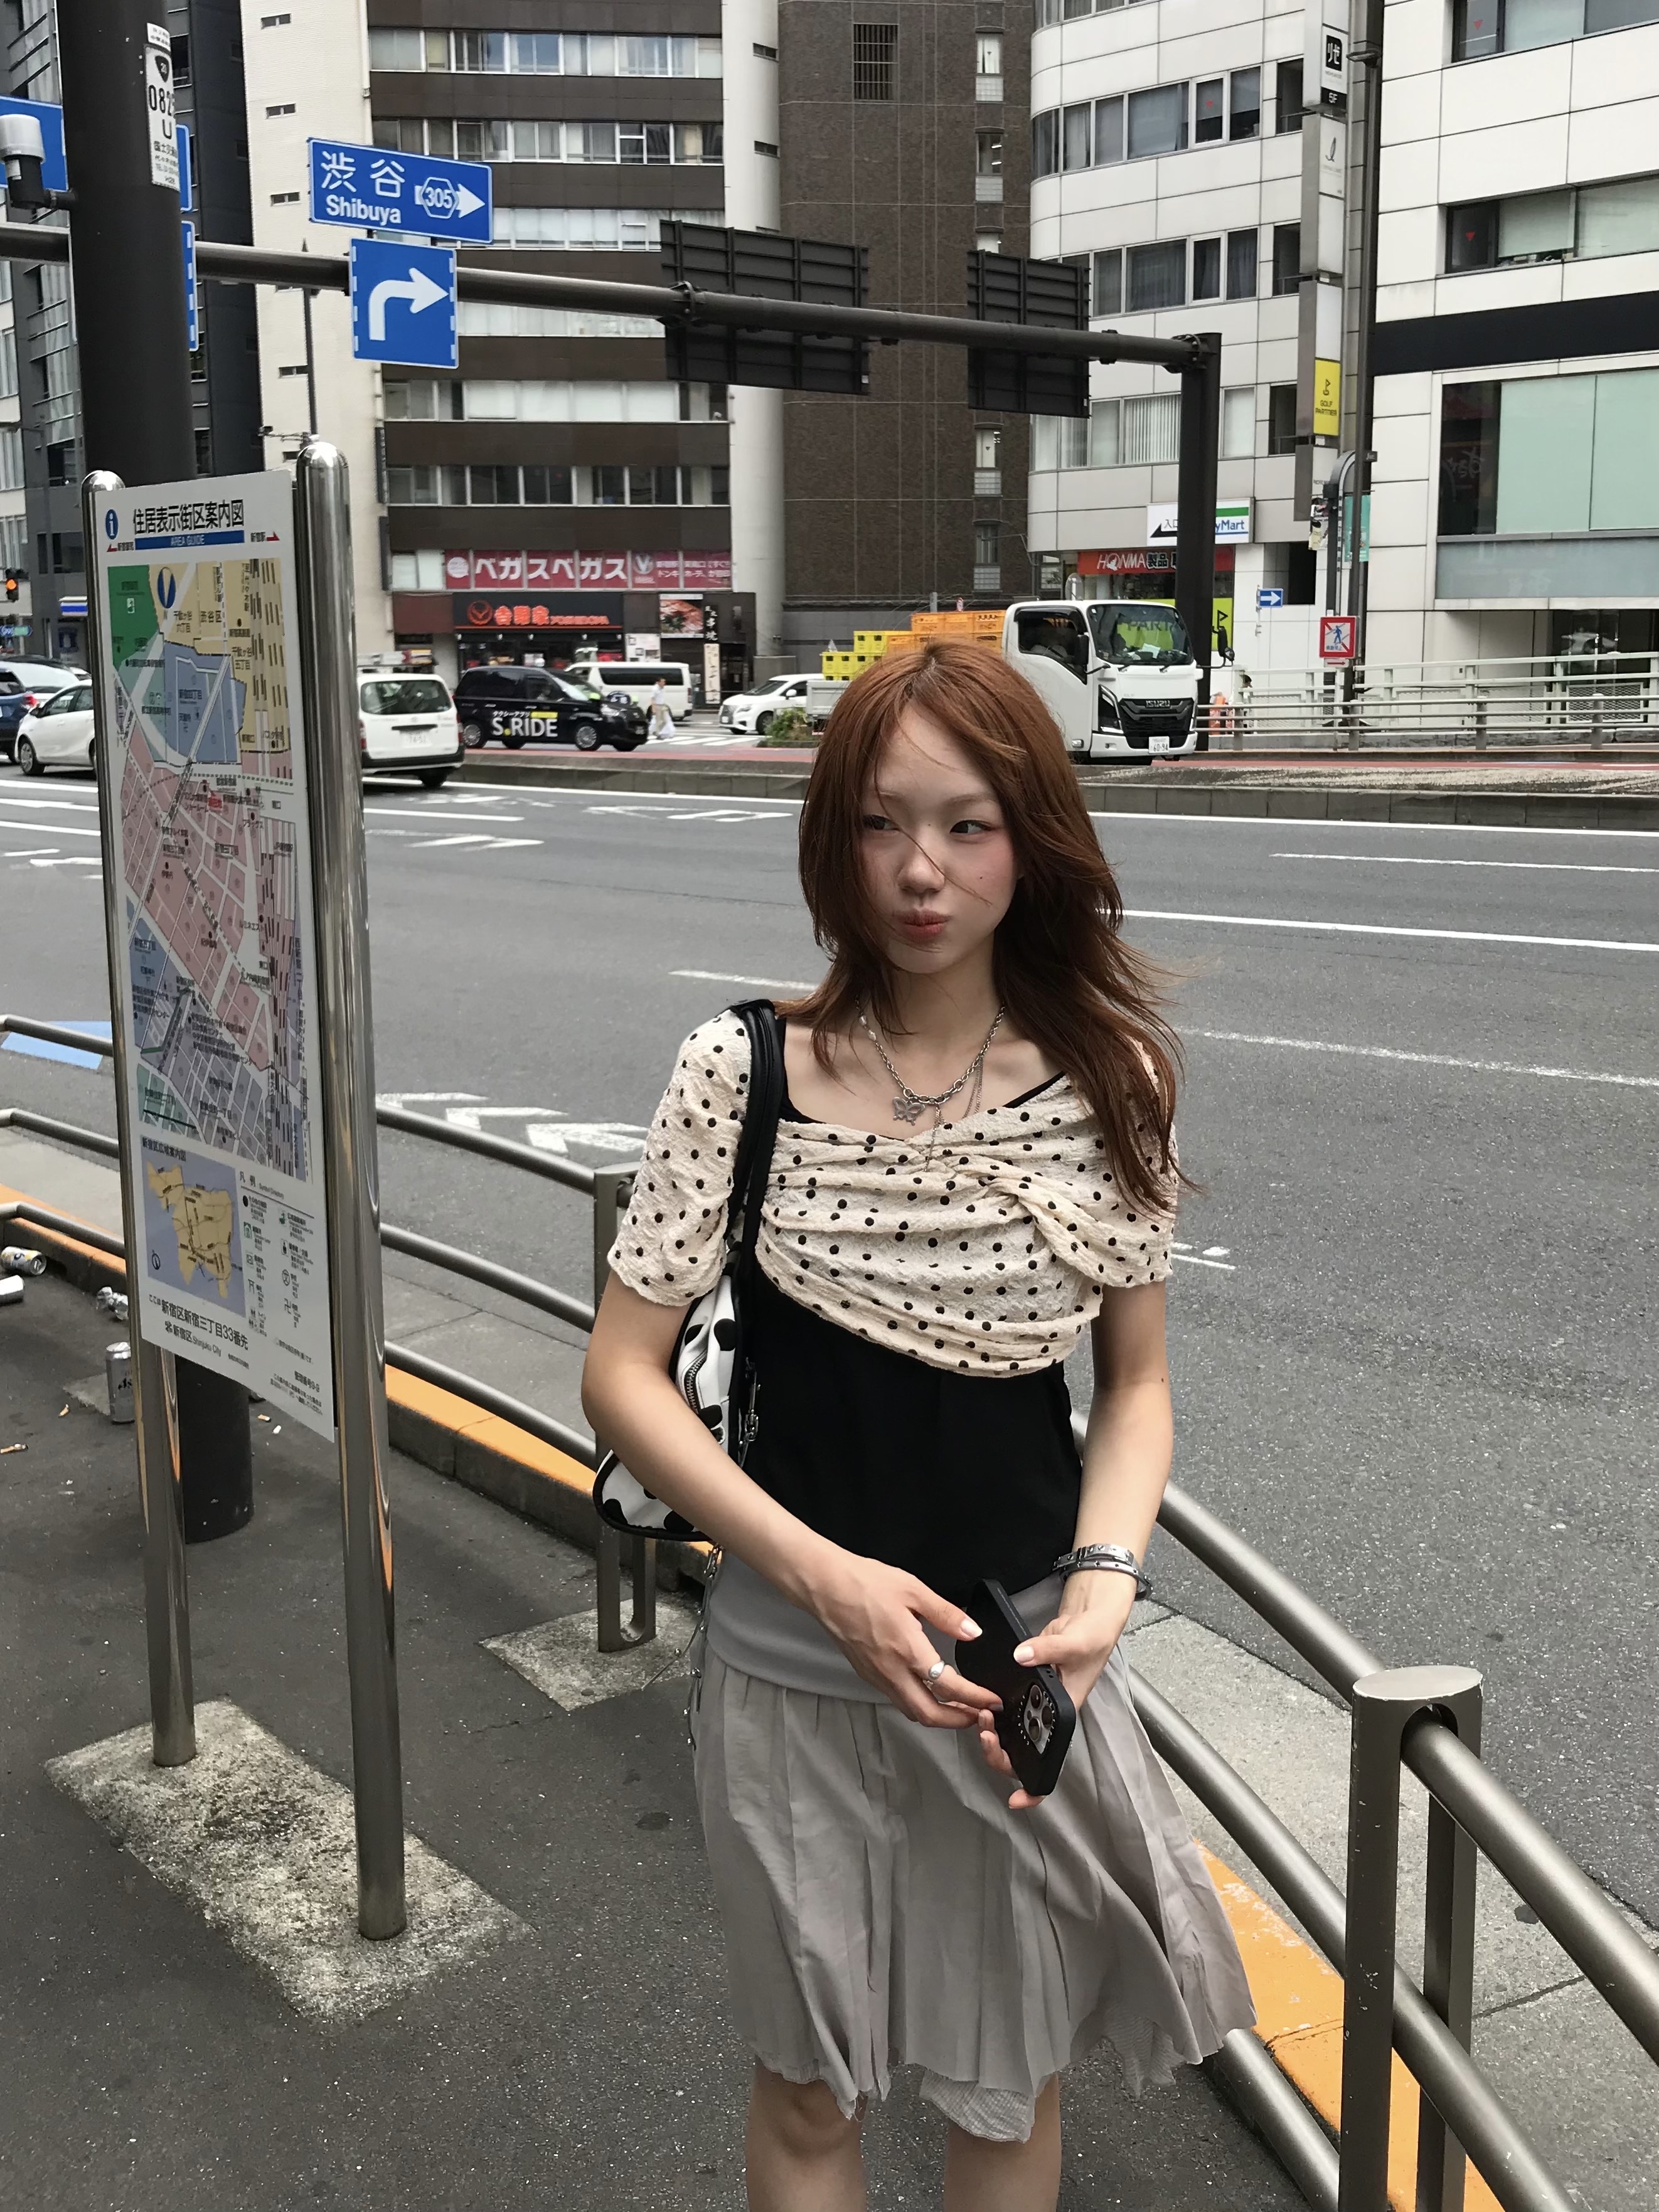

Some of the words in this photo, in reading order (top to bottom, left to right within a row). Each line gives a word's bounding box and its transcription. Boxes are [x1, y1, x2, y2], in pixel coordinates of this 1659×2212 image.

[162, 119, 172, 139] U
[321, 151, 405, 198] 渋谷
[425, 187, 453, 209] 305
[326, 194, 402, 226] Shibuya
[133, 499, 245, 534] 住居表示街区案内図
[170, 536, 186, 546] AREA
[186, 534, 205, 545] GUIDE
[475, 557, 628, 580] ベガスベガス
[1097, 552, 1146, 571] HONMA
[492, 716, 558, 737] S.RIDE
